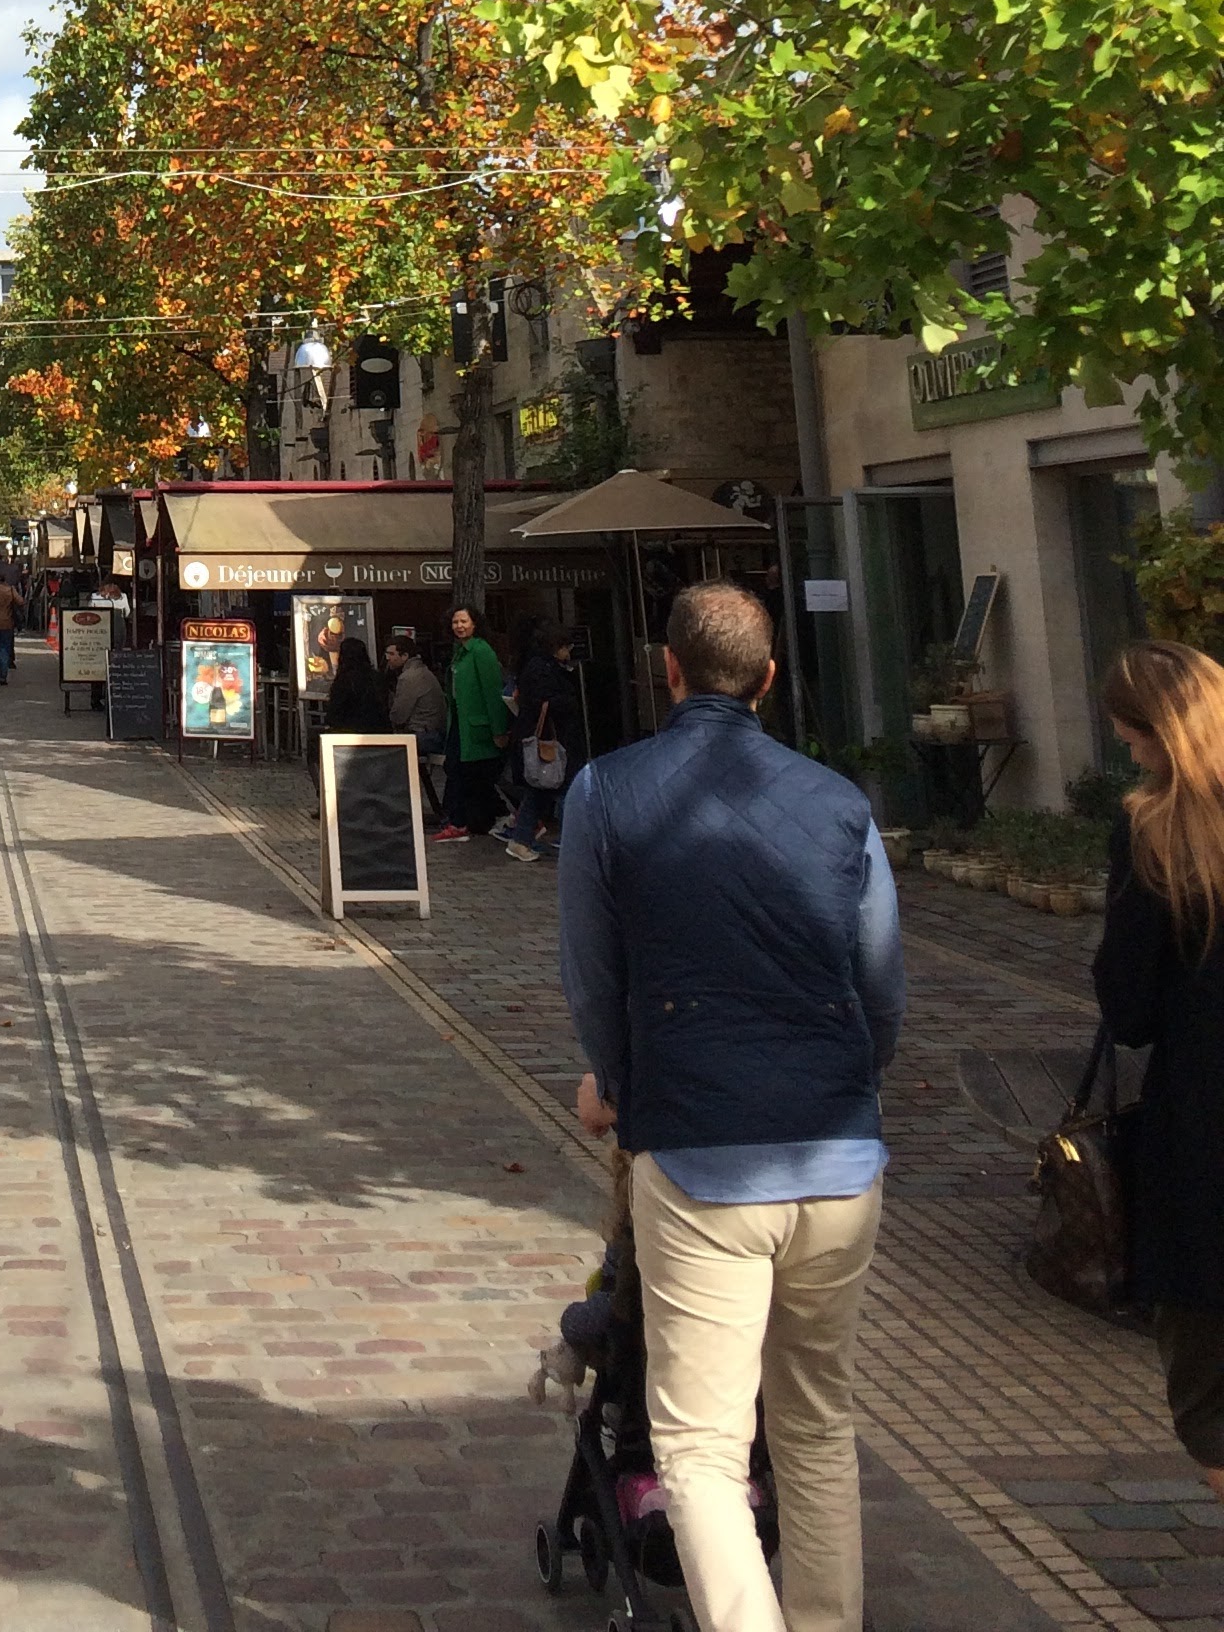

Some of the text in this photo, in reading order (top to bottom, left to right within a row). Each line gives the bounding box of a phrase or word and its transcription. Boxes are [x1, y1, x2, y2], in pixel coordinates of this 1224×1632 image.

[218, 565, 316, 588] Déjeuner
[511, 564, 606, 587] Boutique
[188, 625, 247, 638] NICOLAS
